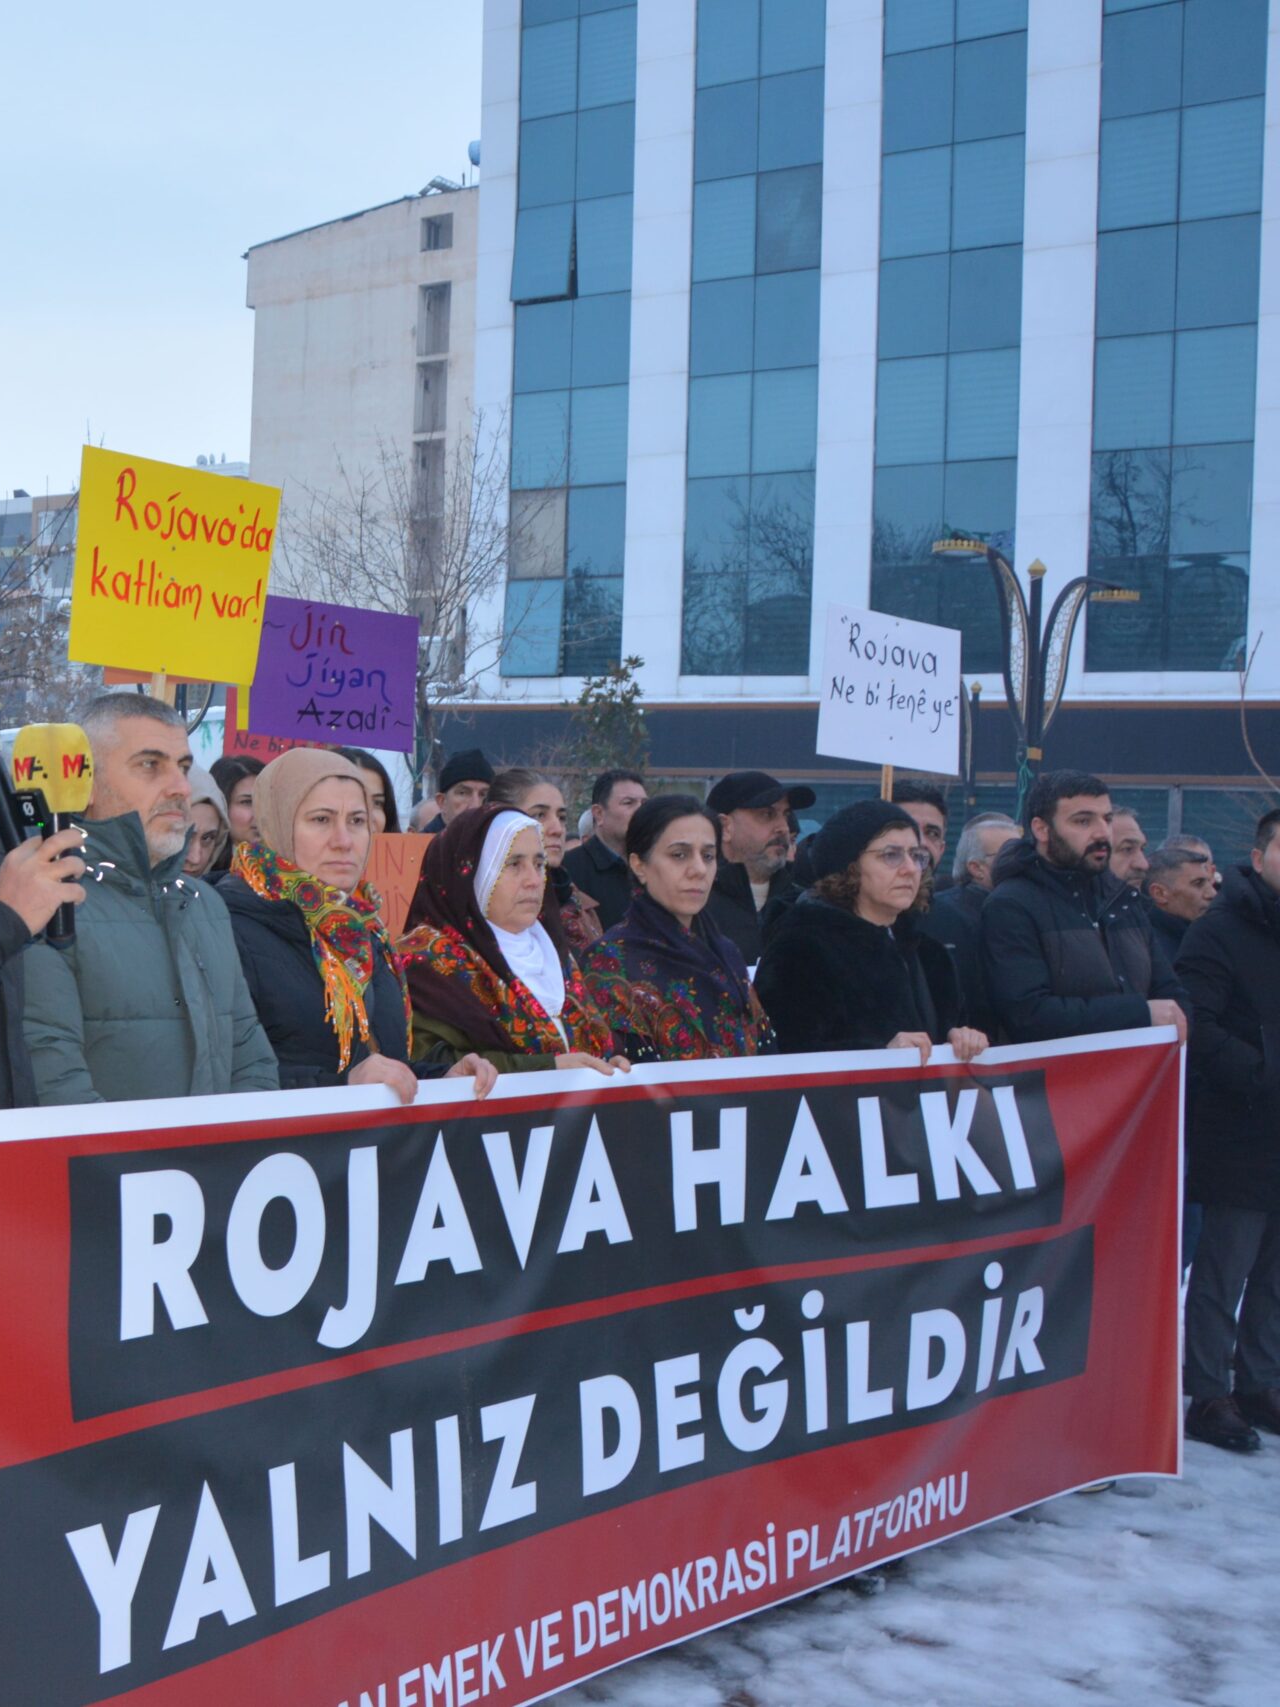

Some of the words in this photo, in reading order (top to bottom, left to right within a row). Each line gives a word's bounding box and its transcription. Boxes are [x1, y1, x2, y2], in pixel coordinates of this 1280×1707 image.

[91, 545, 202, 621] katliam
[290, 605, 354, 655] Jin
[286, 653, 392, 705] Jiyan
[830, 675, 855, 704] Ne
[866, 682, 880, 706] bi
[297, 698, 391, 733] Azadî
[120, 1112, 633, 1349] ROJAVA
[669, 1085, 1036, 1232] HALKI
[65, 1393, 537, 1674] YALNIZ
[579, 1261, 1046, 1497] DEĞİLDİR
[398, 1632, 507, 1707] EMEK
[514, 1610, 564, 1679] VE
[572, 1522, 777, 1658] DEMOKRASİ
[786, 1471, 968, 1579] PLATFORMU
